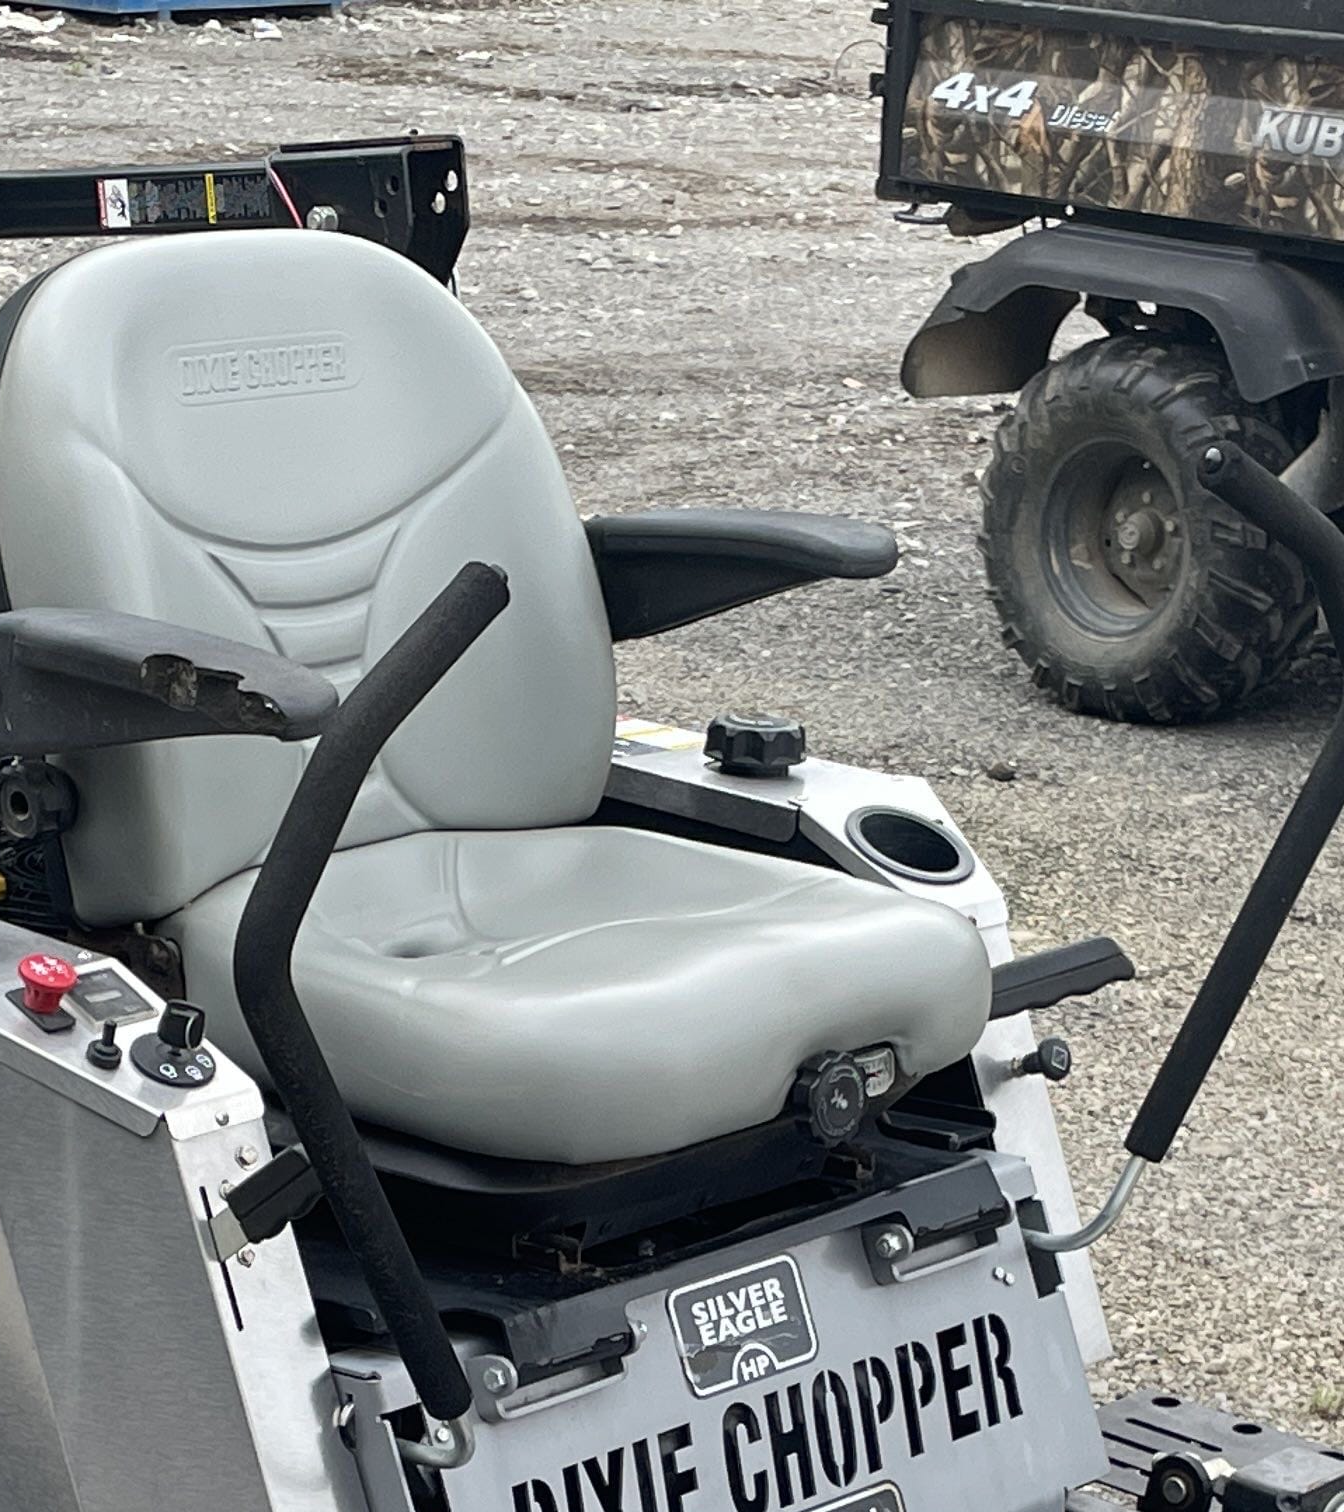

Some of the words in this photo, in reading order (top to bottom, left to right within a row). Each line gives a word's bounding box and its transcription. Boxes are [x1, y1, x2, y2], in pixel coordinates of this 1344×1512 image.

[932, 71, 1038, 119] 4x4
[178, 350, 241, 397] DIXIE
[244, 342, 347, 391] CHOPPER
[690, 1278, 785, 1326] SILVER
[698, 1299, 788, 1346] EAGLE
[740, 1354, 770, 1382] HP
